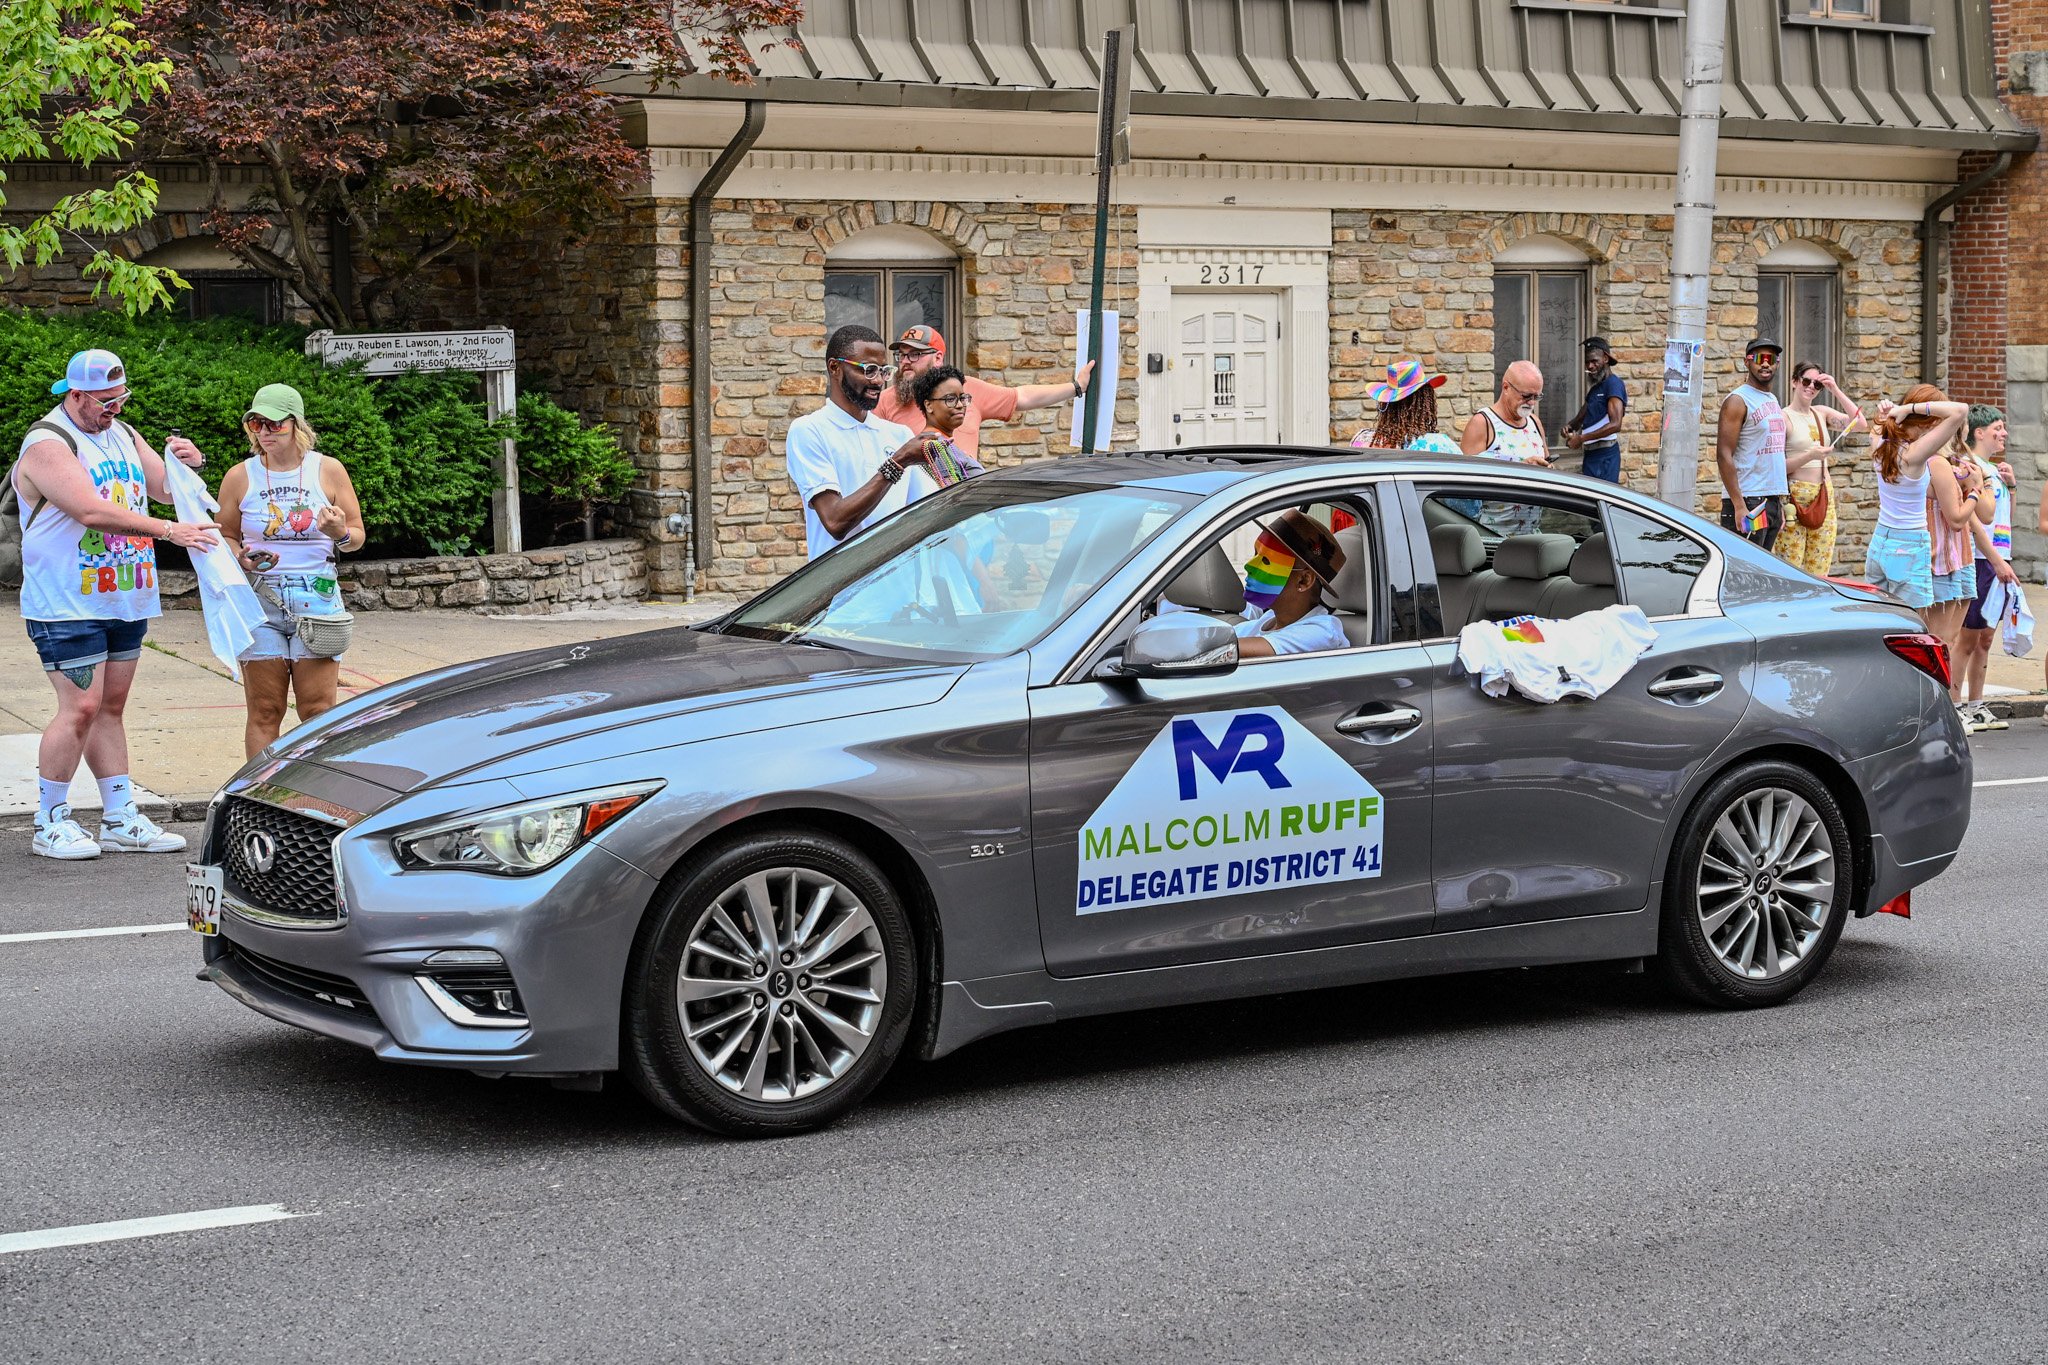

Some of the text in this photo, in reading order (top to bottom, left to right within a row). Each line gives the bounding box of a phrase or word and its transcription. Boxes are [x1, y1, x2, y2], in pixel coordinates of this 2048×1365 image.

[1201, 265, 1264, 284] 2317
[334, 341, 355, 352] Atty.
[357, 340, 392, 350] Reuben
[394, 339, 403, 348] E.
[405, 337, 442, 348] Lawson,
[444, 338, 454, 347] Jr.
[462, 336, 479, 345] 2nd
[481, 336, 504, 345] Floor
[352, 347, 489, 360] Civil Criminal Traffic Bankruptcy
[392, 359, 450, 369] 410-685-6060
[260, 486, 310, 500] Support
[81, 561, 154, 595] FRUIT
[1172, 713, 1292, 801] MR
[1085, 796, 1379, 861] MALCOLM RUFF
[970, 842, 1005, 858] 3.0t
[1078, 843, 1381, 908] DELEGATE DISTRICT 41
